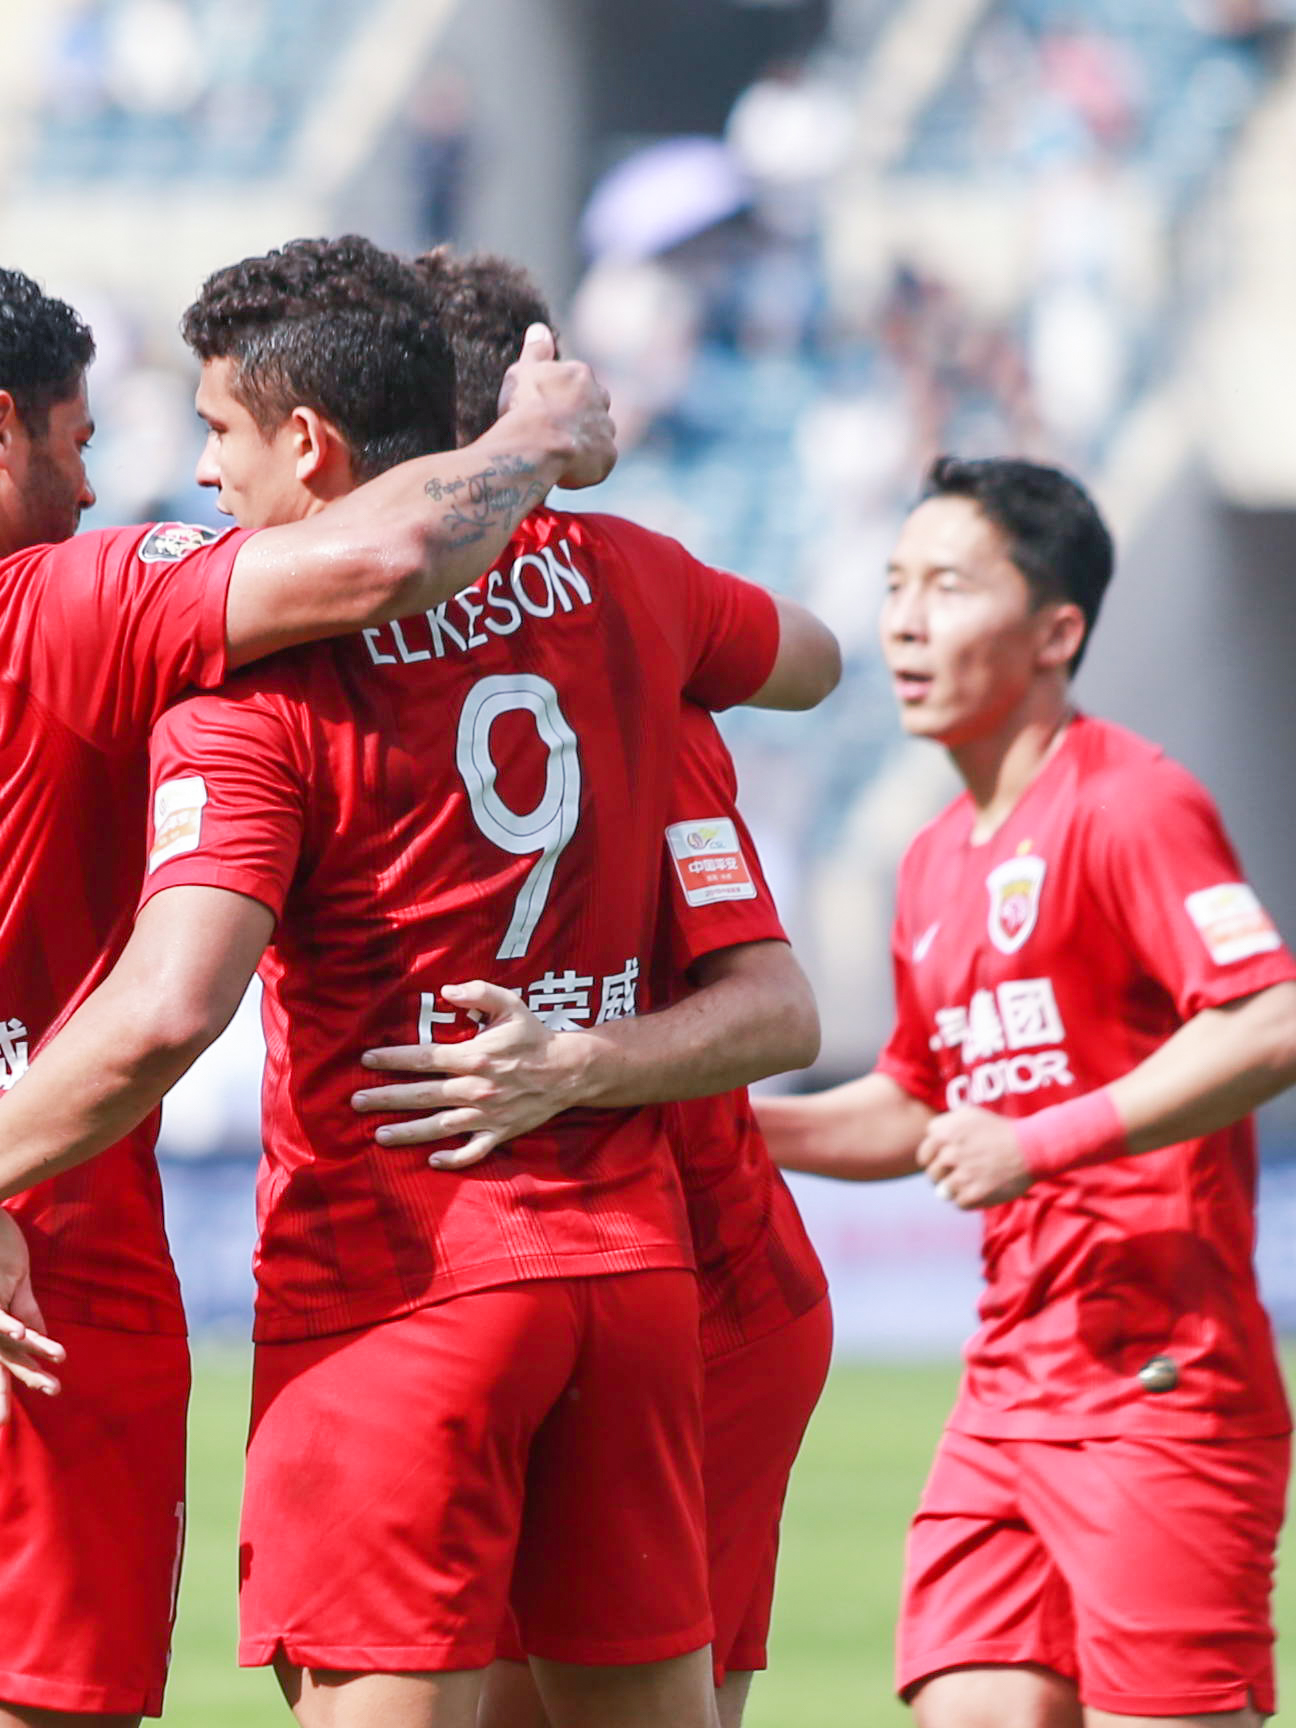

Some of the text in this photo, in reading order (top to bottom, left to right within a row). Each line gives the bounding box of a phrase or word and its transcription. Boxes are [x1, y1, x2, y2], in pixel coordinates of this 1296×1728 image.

[362, 538, 593, 665] ELKESON
[456, 673, 581, 960] 9
[418, 957, 640, 1045] 上荣威
